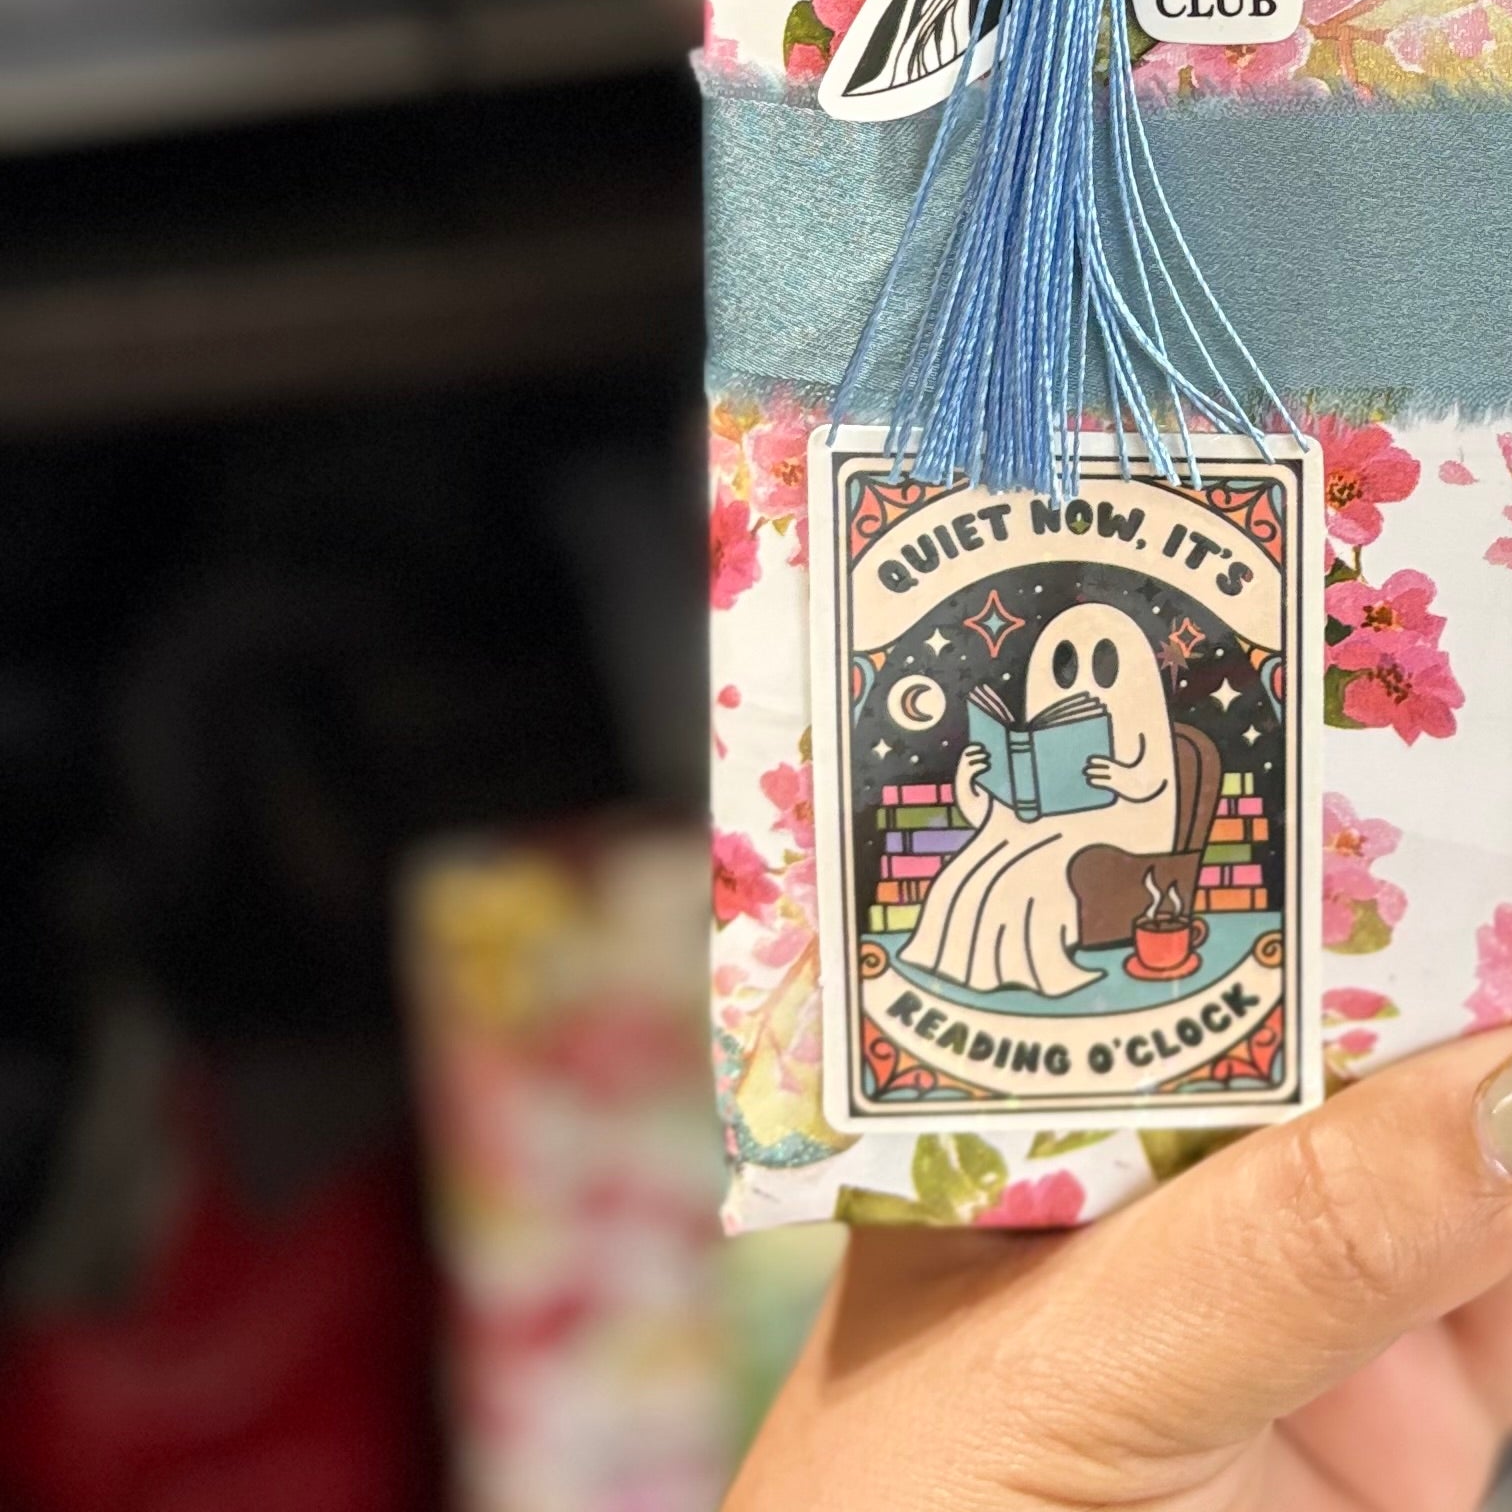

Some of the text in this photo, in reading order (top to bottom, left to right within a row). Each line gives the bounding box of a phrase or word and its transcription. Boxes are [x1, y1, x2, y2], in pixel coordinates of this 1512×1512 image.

[877, 498, 1255, 597] QUIET NOW, IT'S
[885, 981, 1261, 1077] READING O'CLOCK
